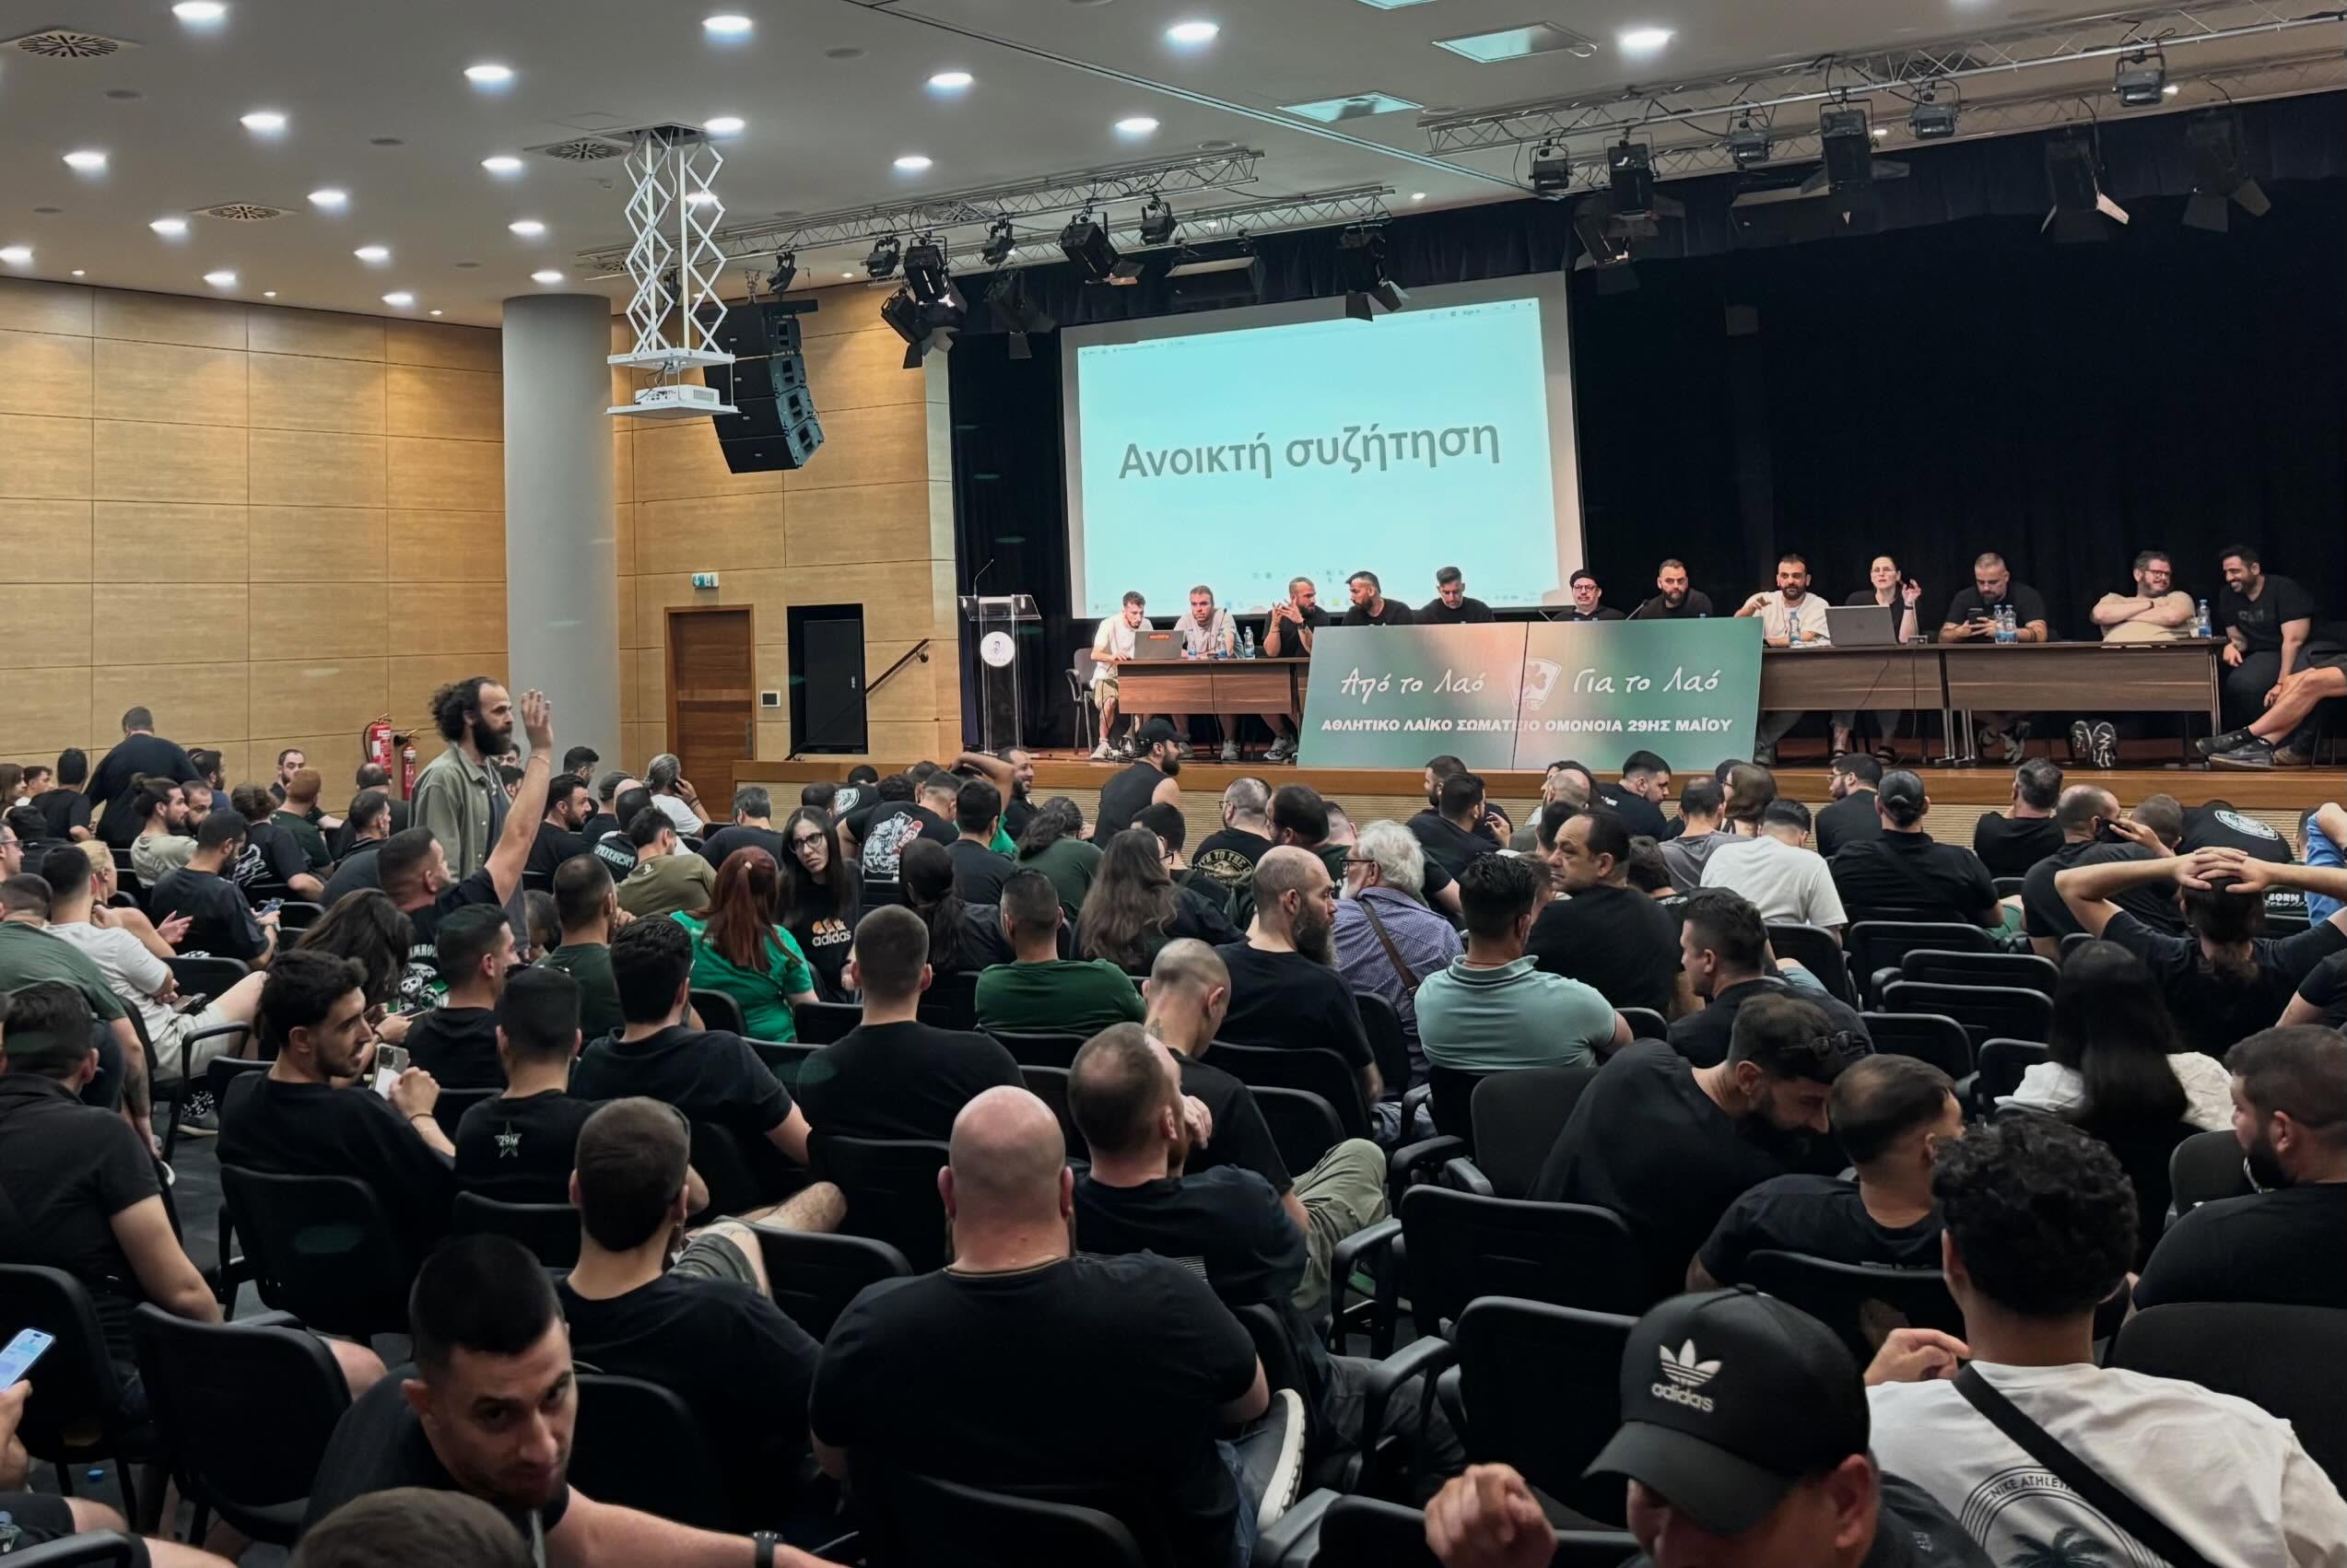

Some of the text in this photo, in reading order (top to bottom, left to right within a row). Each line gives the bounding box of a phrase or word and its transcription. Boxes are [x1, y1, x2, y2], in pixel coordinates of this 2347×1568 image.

[1119, 423, 1500, 479] Ανοικτή συζήτηση
[1341, 667, 1486, 705] Από το Λαό
[1574, 665, 1721, 694] Για το Λαό
[1320, 717, 1732, 732] ΑΘΛΗΤΙΚΟ ΛΑΪΚΟ ΣΩΜΑΤΕΙΟ ΟΜΟΝΟΙΑ 29ΗΣ ΜΑΪΟΥ
[812, 930, 851, 947] adidas
[1651, 1383, 1714, 1412] adidas
[1990, 1475, 2072, 1499] NIKE ATHLET
